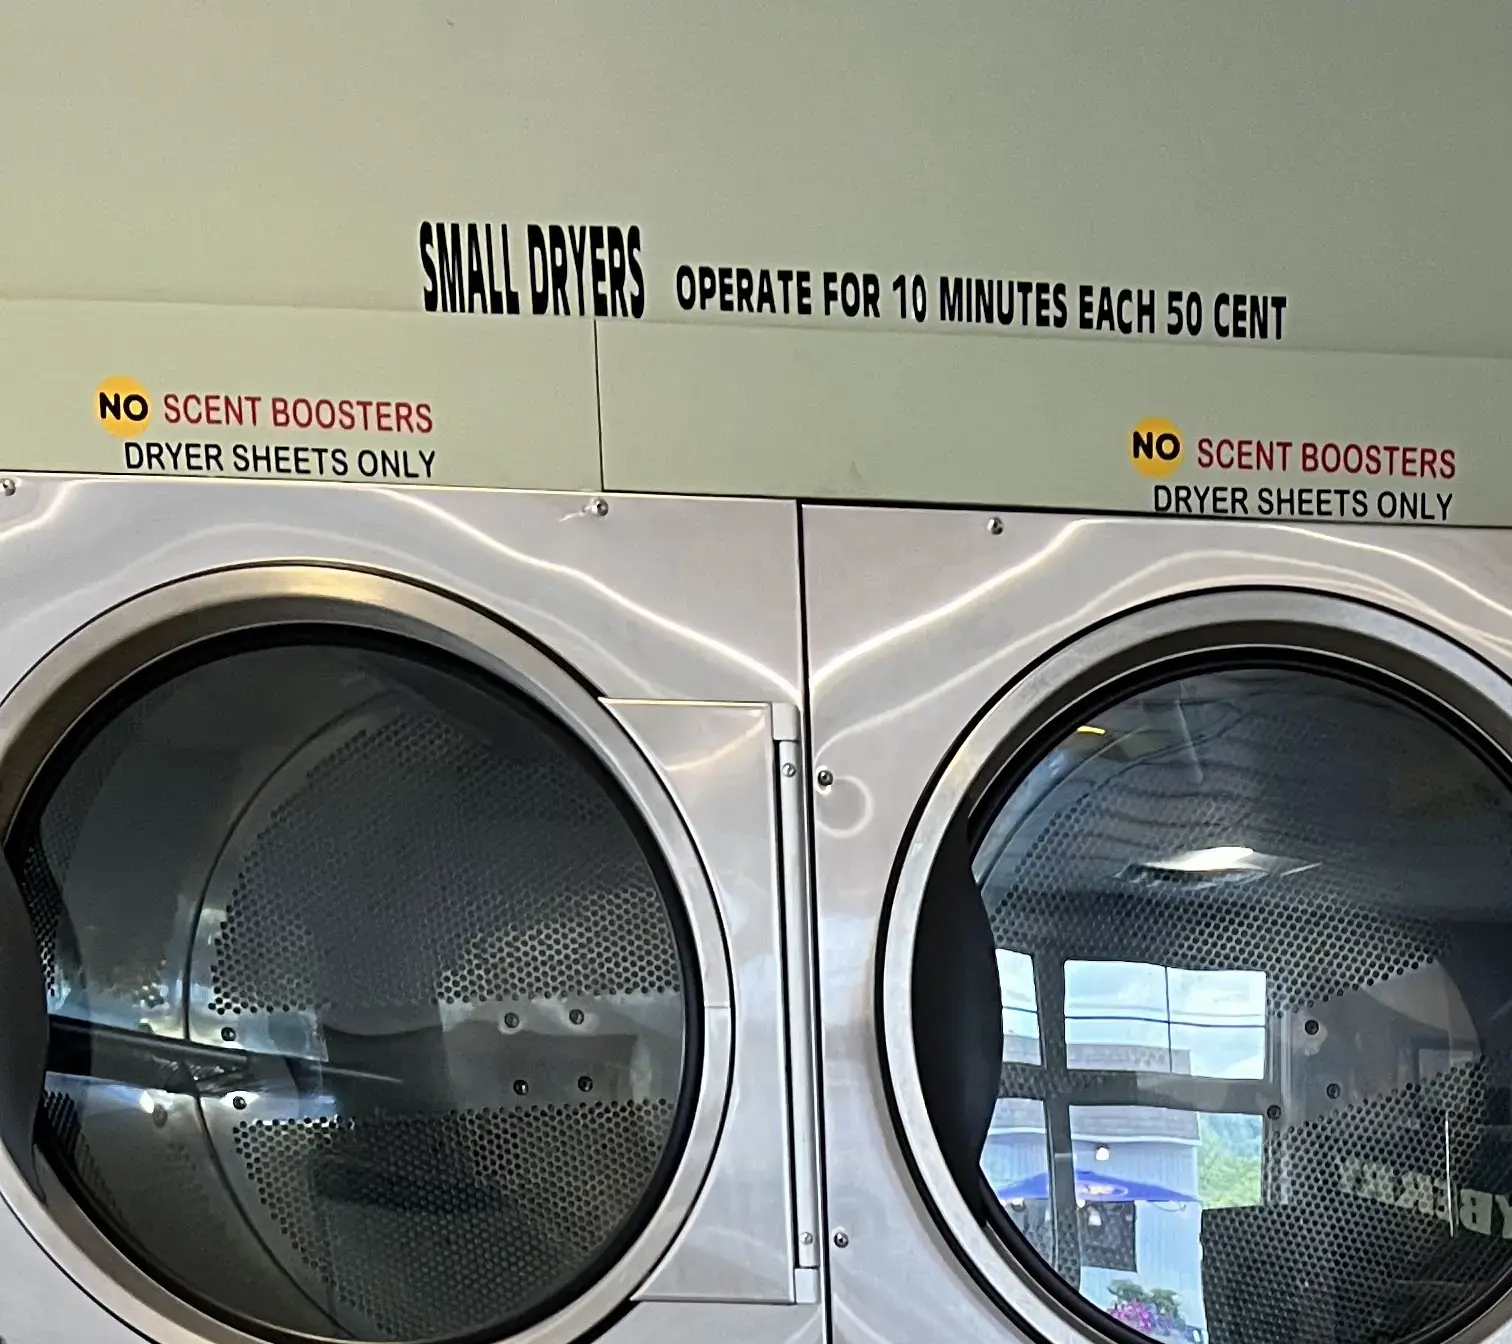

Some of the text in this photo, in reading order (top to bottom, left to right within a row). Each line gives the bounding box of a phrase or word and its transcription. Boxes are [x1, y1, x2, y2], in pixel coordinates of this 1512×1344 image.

[419, 221, 645, 319] SMALL DRYERS
[676, 264, 1287, 340] OPERATE FOR 10 MINUTES EACH 50 CENT
[99, 392, 433, 434] NO SCENT BOOSTERS
[124, 441, 436, 479] DRYER SHEETS ONLY
[1133, 431, 1456, 480] NO SCENT BOOSTERS
[1153, 484, 1453, 521] DRYER SHEETS ONLY
